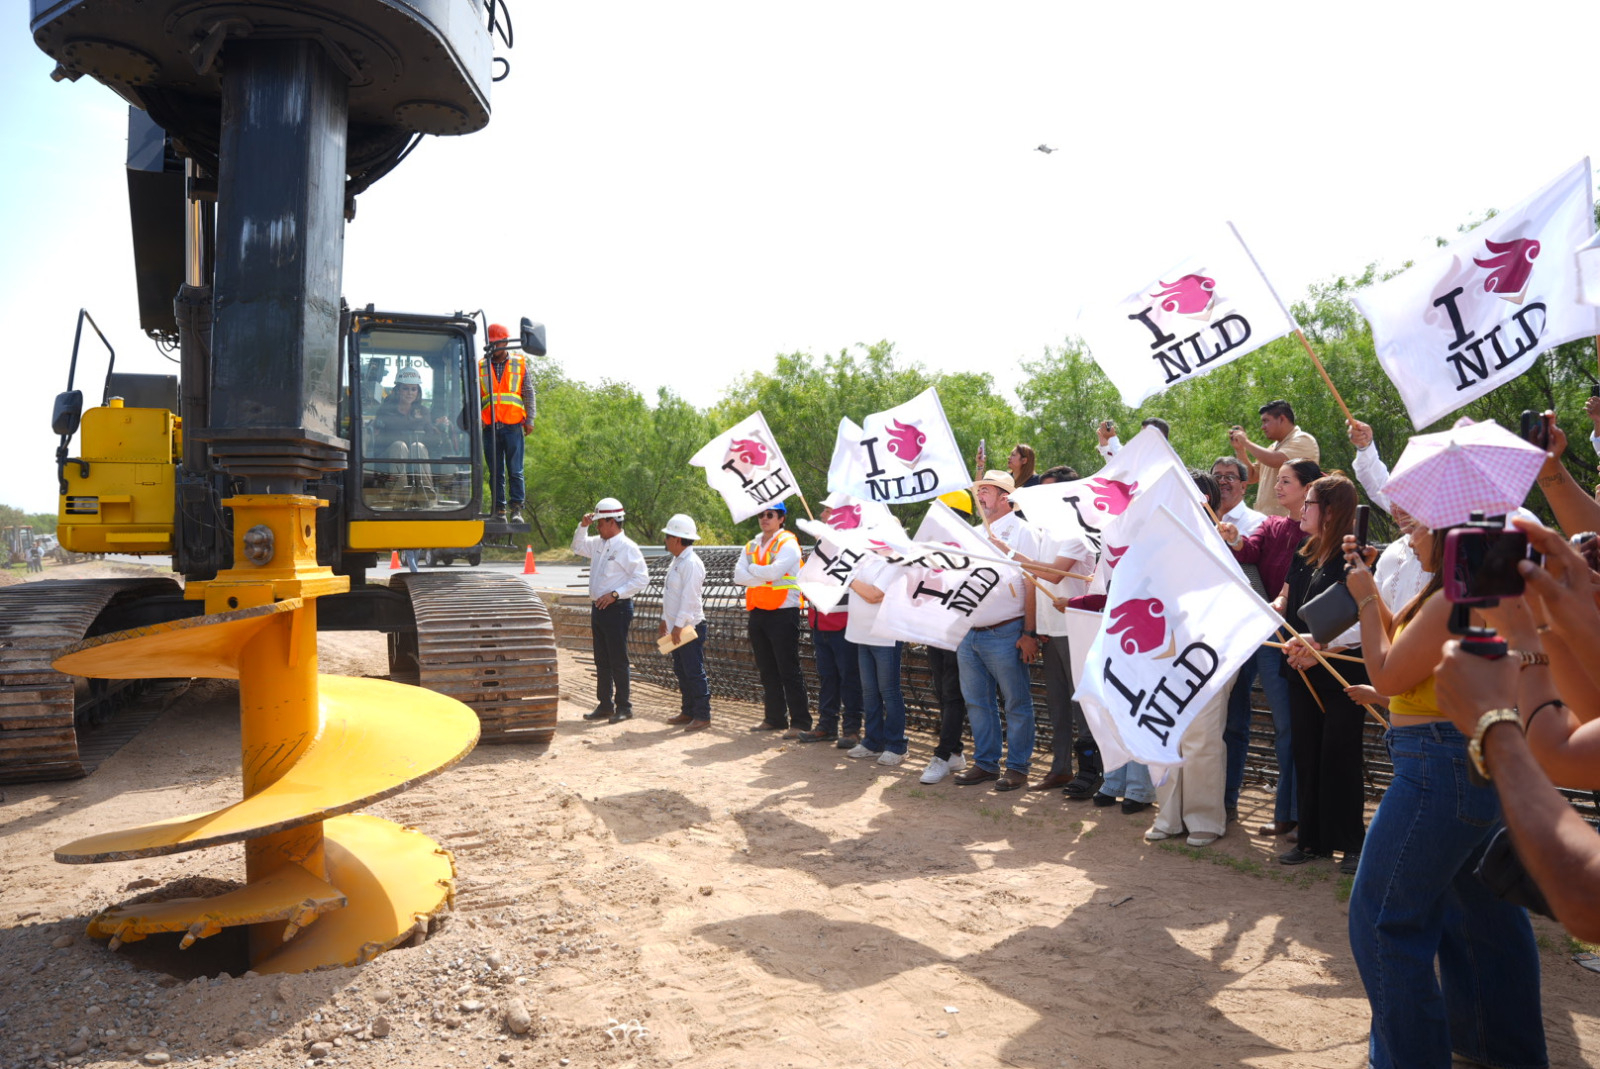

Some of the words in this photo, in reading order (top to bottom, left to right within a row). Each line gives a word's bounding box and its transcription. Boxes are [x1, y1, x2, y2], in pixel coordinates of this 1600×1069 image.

[1128, 305, 1175, 350] I
[1433, 286, 1476, 351] I
[1151, 314, 1252, 384] NLD
[1446, 302, 1547, 391] NLD
[722, 459, 754, 488] I
[861, 437, 886, 478] I
[866, 468, 940, 502] NLD
[814, 539, 839, 571] I
[912, 580, 954, 606] I
[946, 567, 1000, 617] NLD
[1104, 657, 1146, 717] I
[1138, 641, 1219, 747] NLD
